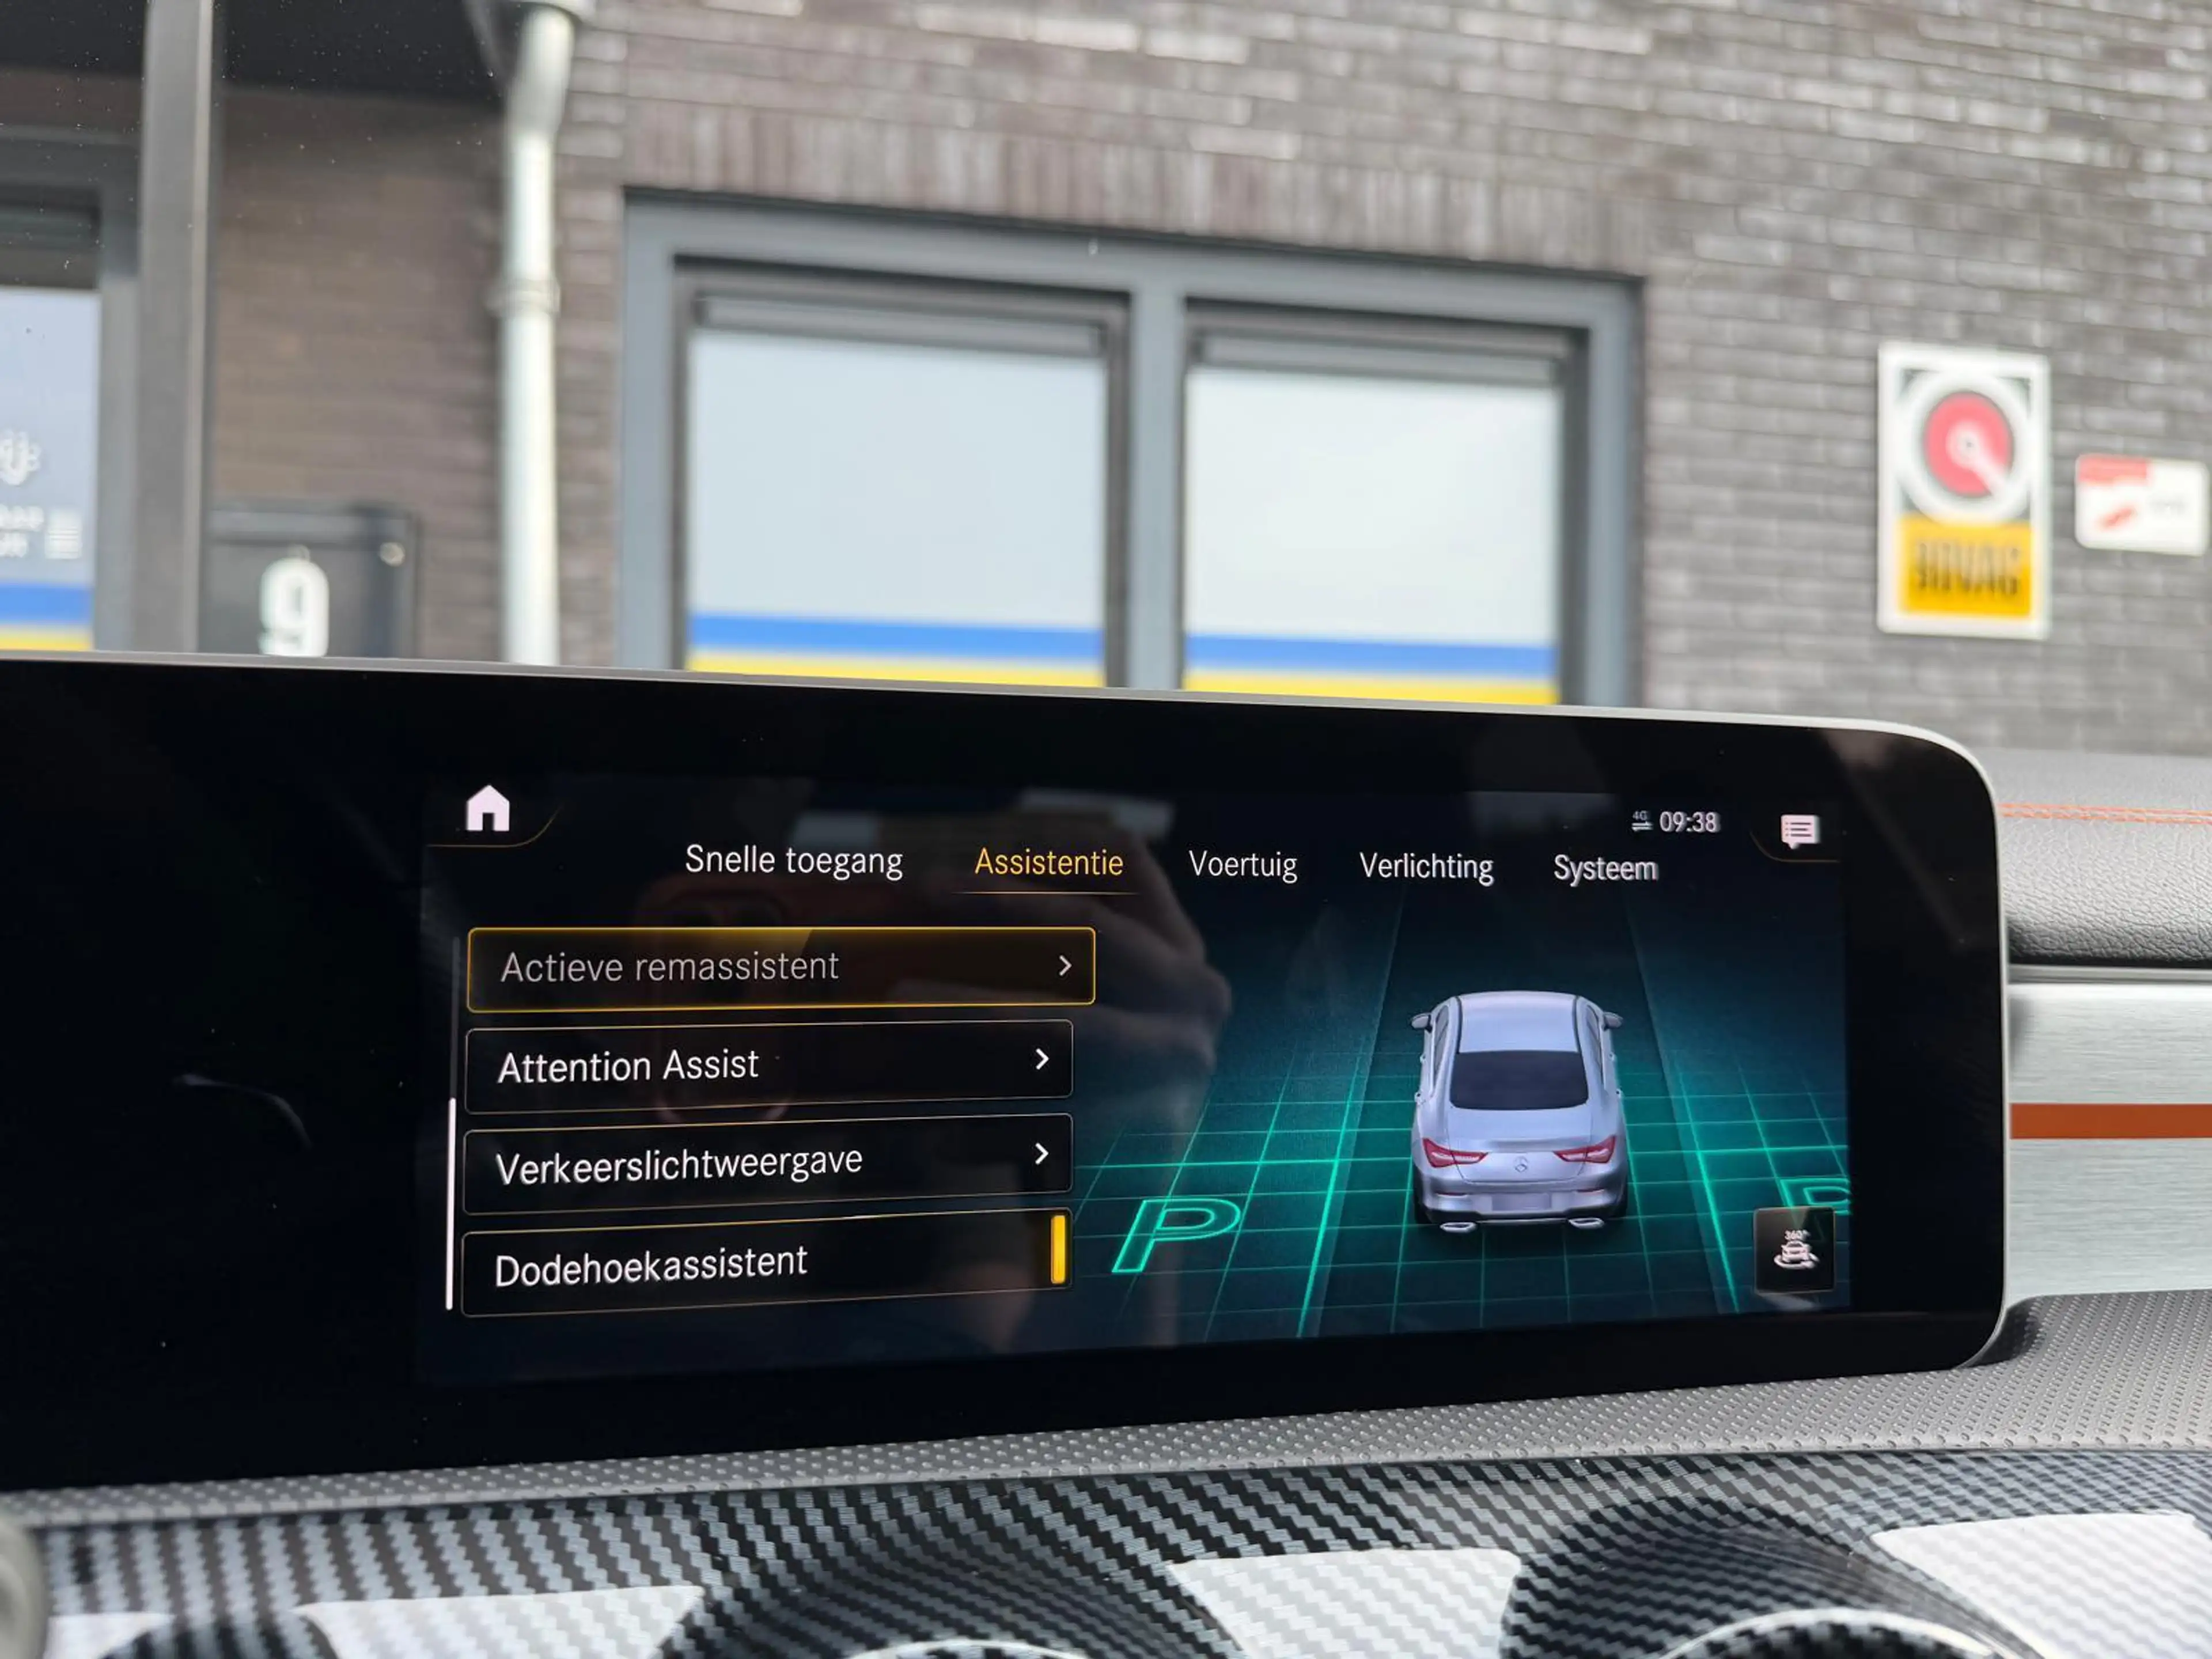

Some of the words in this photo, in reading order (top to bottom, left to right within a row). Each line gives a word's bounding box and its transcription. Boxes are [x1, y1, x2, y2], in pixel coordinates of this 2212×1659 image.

[259, 557, 329, 657] 9
[1659, 810, 1720, 834] 09:38
[685, 843, 775, 874] Snelle
[785, 847, 904, 881] toegang
[974, 847, 1124, 876] Assistentie
[1188, 850, 1298, 884] Voertuig
[1359, 851, 1495, 887] Verlichting
[1554, 854, 1659, 888] Systeem
[500, 951, 624, 983] Actieve
[636, 950, 840, 982] remassistent
[497, 1050, 652, 1084] Attention
[662, 1048, 760, 1080] Assist
[495, 1148, 863, 1185] Verkeerslichtweergave
[1112, 1198, 1241, 1273] P
[495, 1245, 809, 1287] Dodehoekassistent
